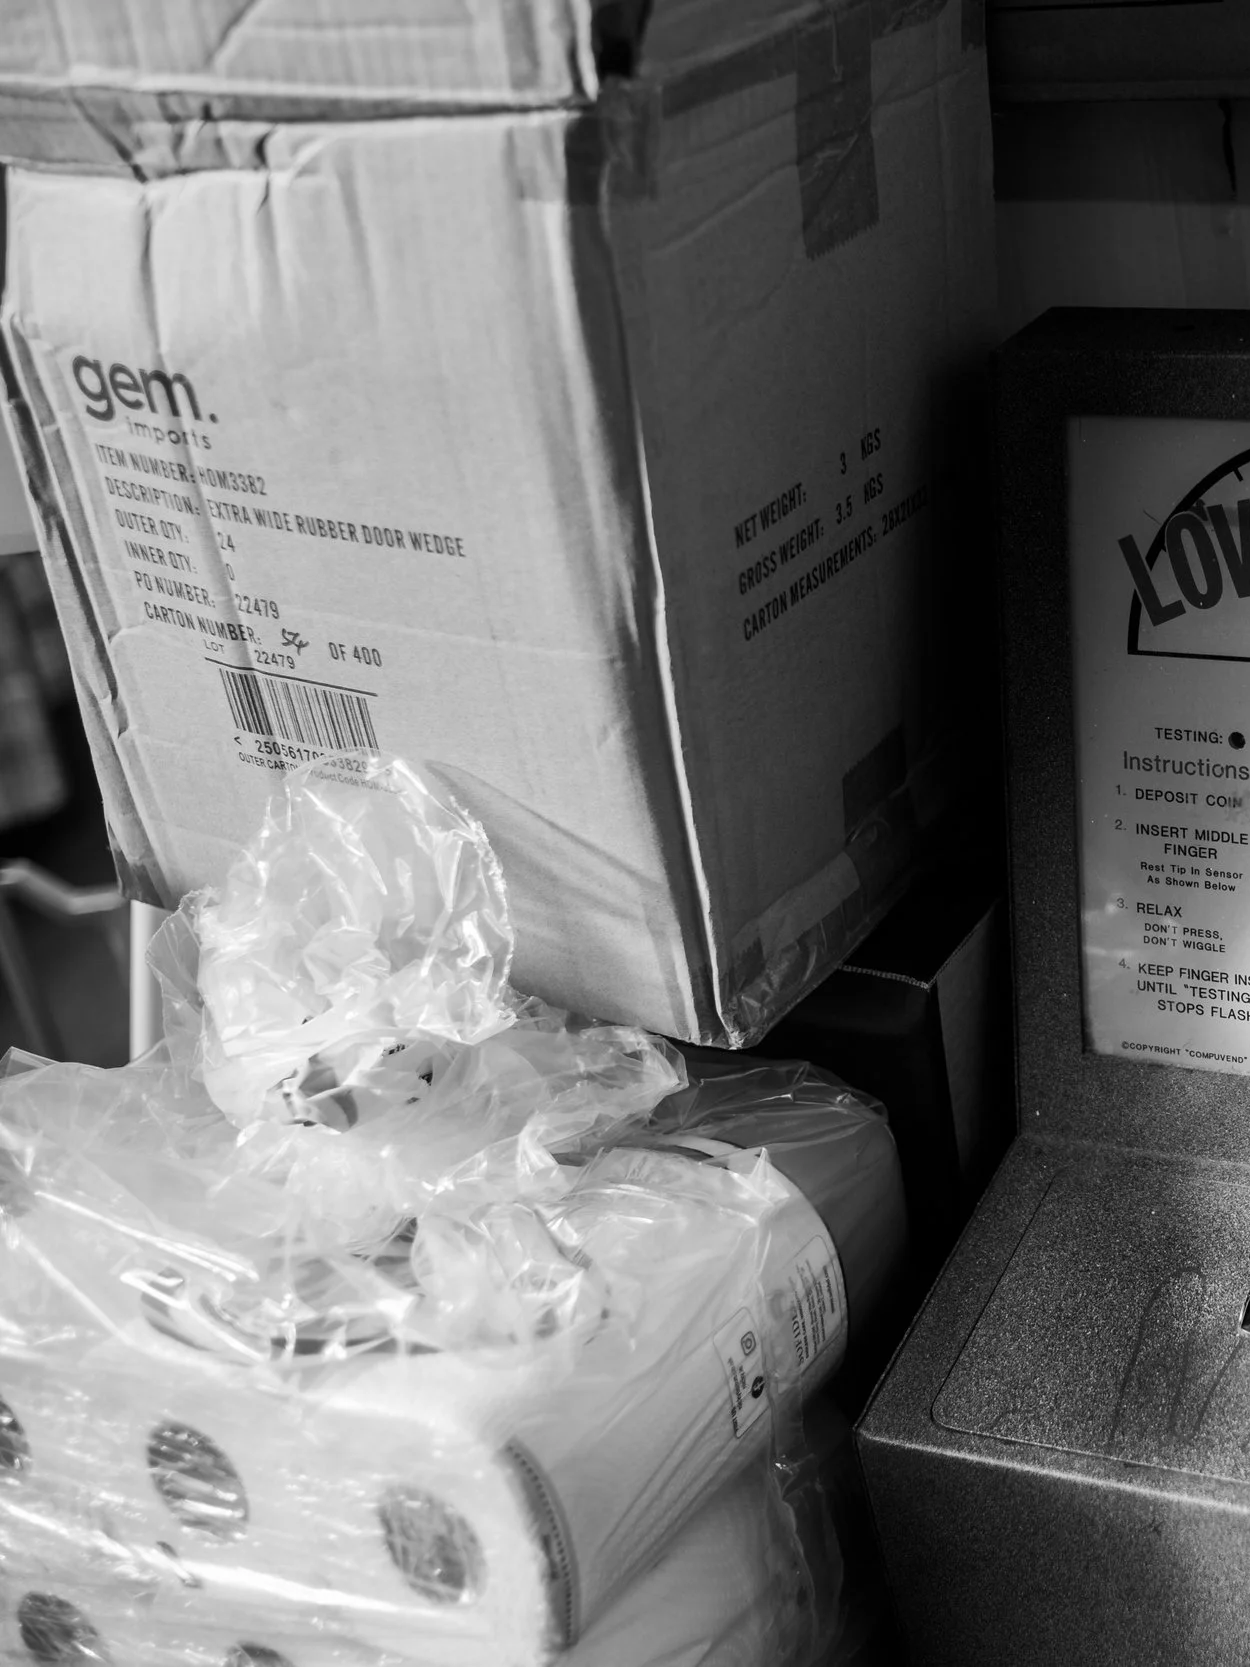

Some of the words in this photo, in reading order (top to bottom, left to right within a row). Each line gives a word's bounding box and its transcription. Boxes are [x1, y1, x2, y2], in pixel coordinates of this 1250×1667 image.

[72, 355, 219, 422] gem.
[126, 417, 212, 450] imports
[97, 443, 127, 470] ITEM
[131, 452, 195, 483] NUMBER:
[733, 513, 757, 549] NET
[759, 482, 807, 532] WEIGHT:
[839, 452, 847, 475] 3
[860, 428, 881, 461] KGS
[105, 477, 200, 516] DESCRIPTION:
[209, 499, 252, 527] EXTRA
[256, 507, 293, 533] WIDE
[295, 514, 357, 545] RUBBER
[363, 525, 406, 550] DOOR
[409, 531, 466, 558] WEDGE
[115, 509, 157, 536] OUTER
[162, 518, 189, 544] QTY:
[218, 531, 235, 554] 24
[738, 551, 777, 596] GROSS
[778, 518, 824, 565] WEIGHT:
[835, 495, 853, 524] 3.5
[863, 473, 884, 504] KGS
[124, 540, 166, 567] INNER
[169, 550, 197, 574] QTY:
[134, 571, 153, 592] PO
[156, 576, 215, 608] NUMBER:
[234, 593, 279, 620] 22479
[743, 591, 788, 641] CARTON
[790, 526, 877, 606] MEASUREMENTS:
[145, 602, 195, 632] CARTON
[198, 615, 262, 646] NUMBER:
[205, 640, 225, 655] LOT
[254, 650, 295, 669] 22479
[328, 642, 347, 662] OF
[352, 645, 382, 668] 400
[1155, 727, 1223, 744] TESTING:
[238, 751, 266, 768] OUTER
[1115, 785, 1127, 796] 1.
[1135, 787, 1198, 805] DEPOSIT
[1115, 819, 1127, 831] 2.
[1136, 823, 1188, 840] INSERT
[1195, 829, 1249, 846] MIDDLE
[1164, 843, 1218, 860] FINGER
[1140, 862, 1165, 873] Rest
[1170, 864, 1186, 876] Tip
[1191, 866, 1200, 876] In
[1205, 868, 1244, 880] Sensor
[1147, 874, 1160, 885] As
[1165, 876, 1200, 889] Shown
[1204, 880, 1236, 893] Below
[1116, 898, 1129, 910] 3.
[1136, 902, 1183, 918] RELAX
[1143, 935, 1177, 948] DON'T
[1182, 940, 1226, 953] WIGGLE
[1144, 922, 1178, 935] DON'T
[1183, 927, 1224, 941] PRESS,
[1118, 958, 1131, 970] 4.
[1138, 963, 1174, 977] KEEP
[1179, 967, 1230, 984] FINGER
[1136, 980, 1177, 995] UNTIL
[1157, 999, 1205, 1016] STOPS
